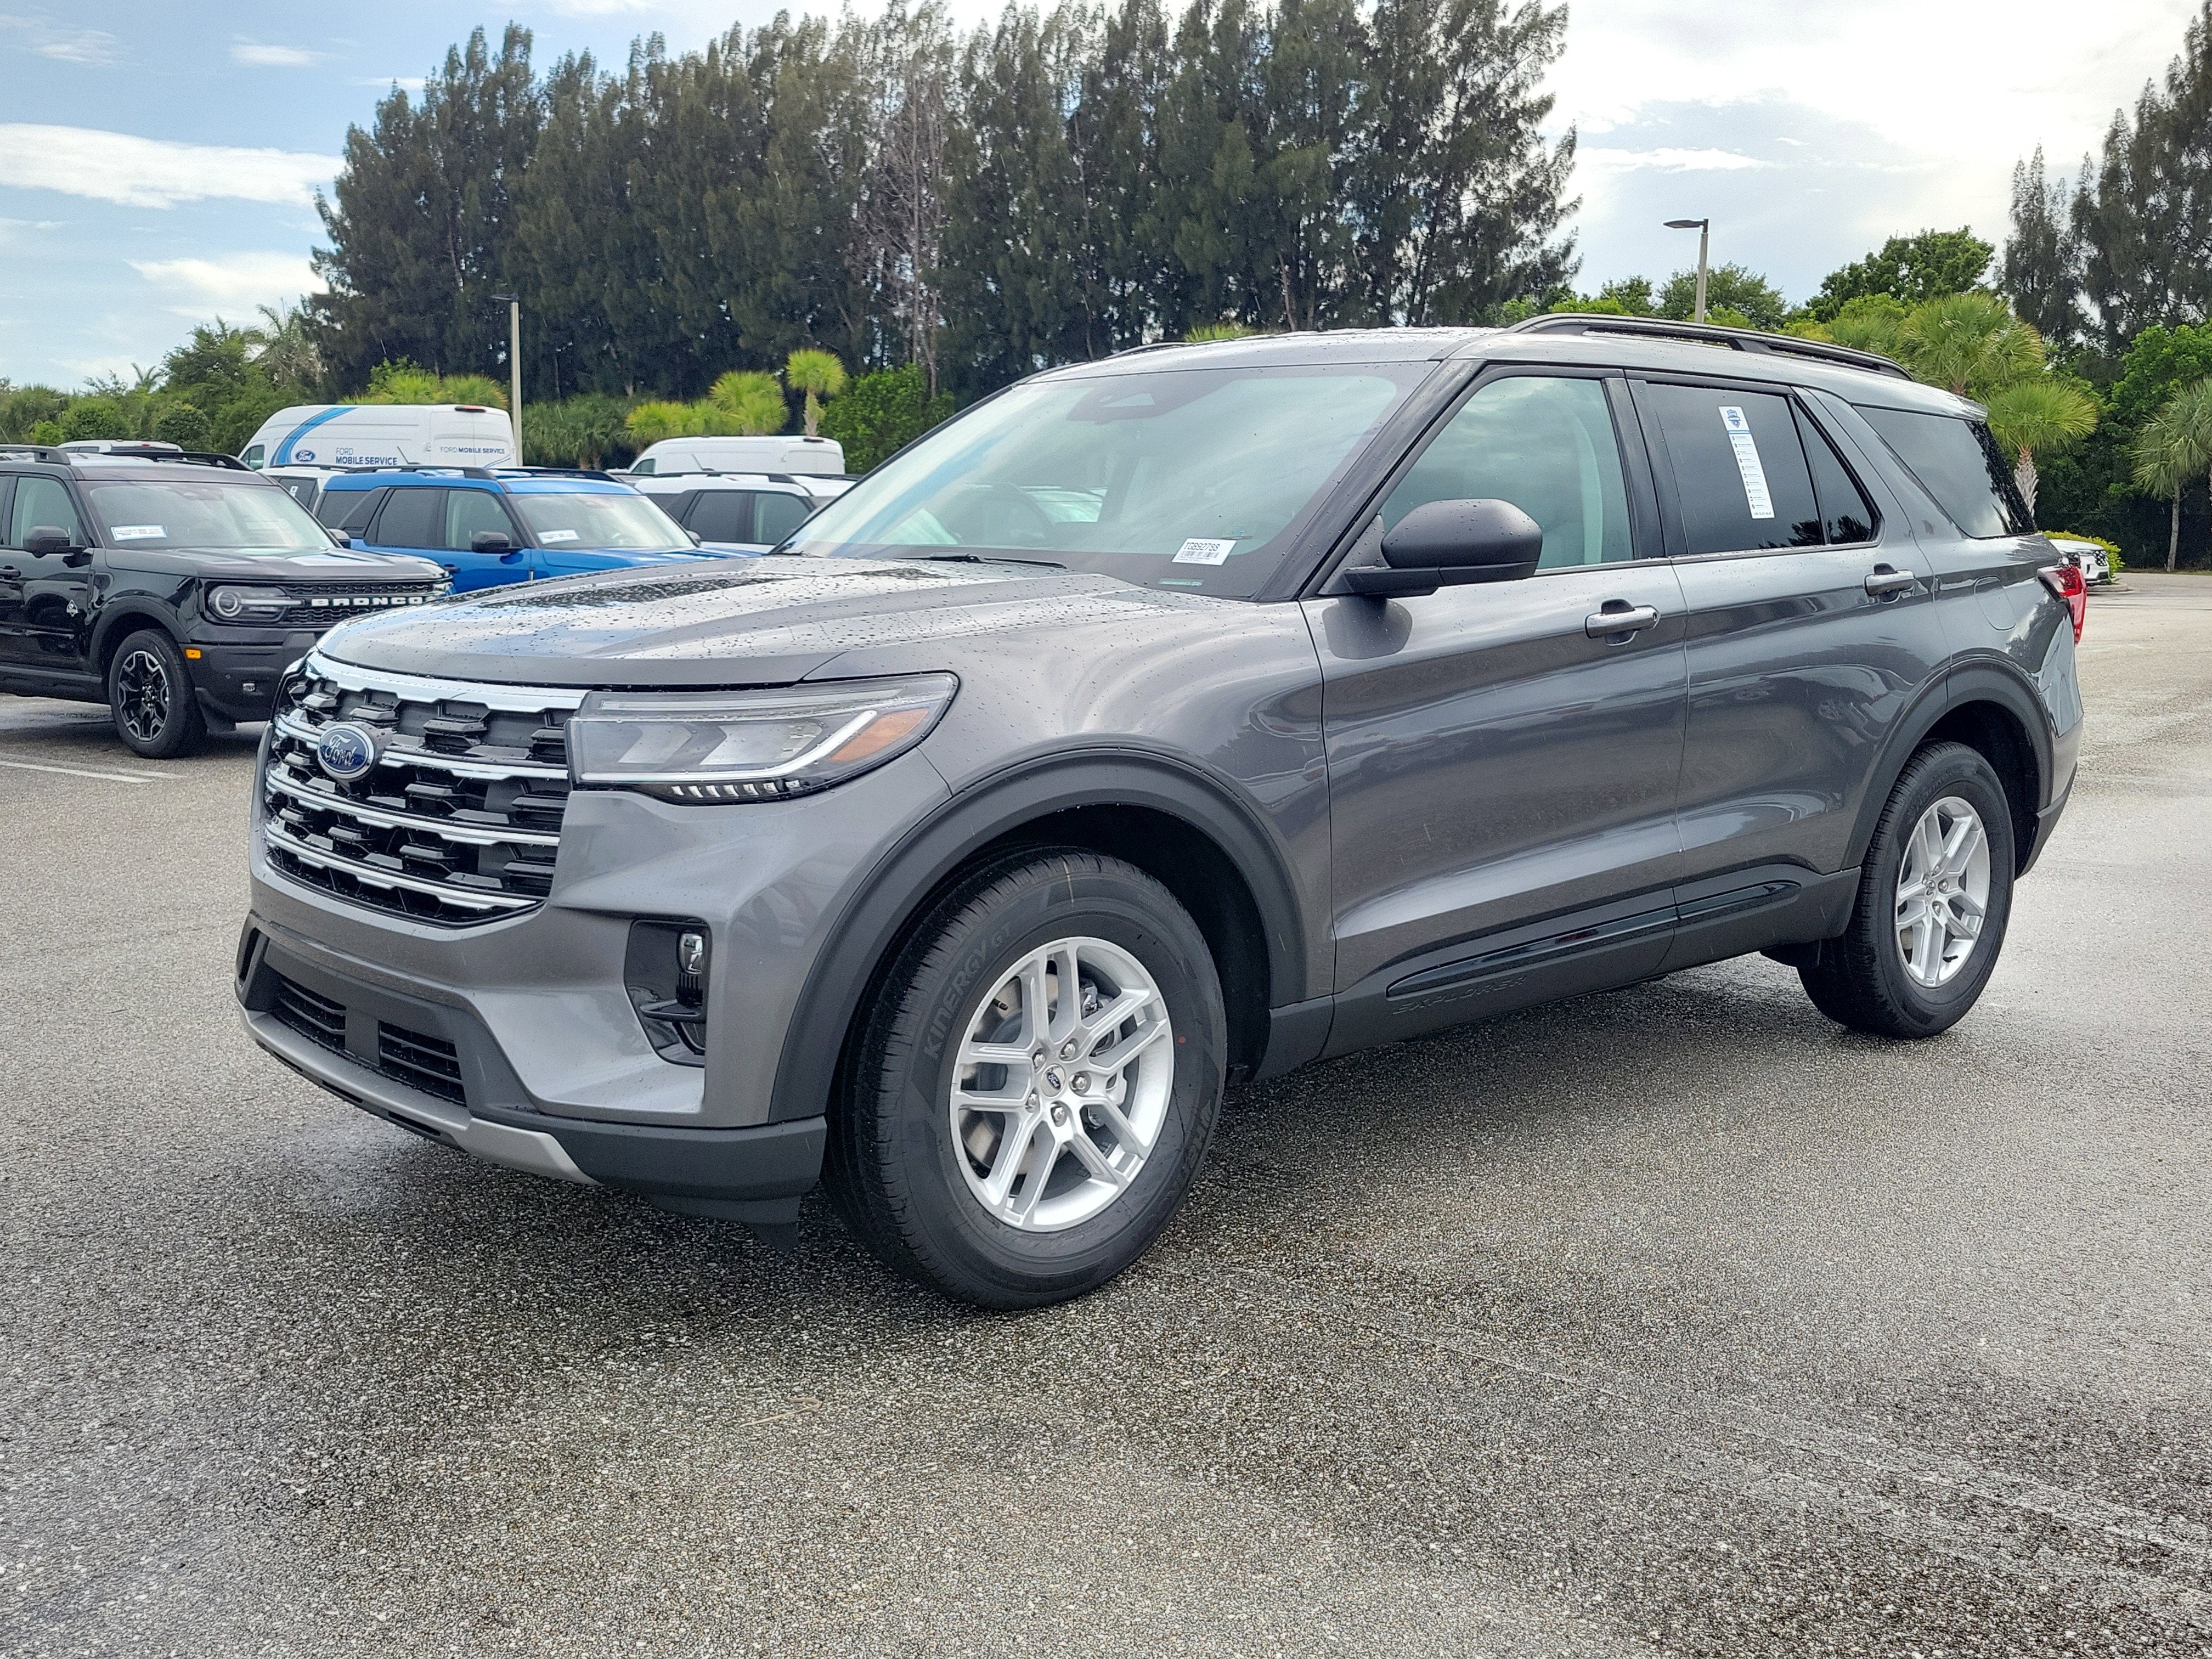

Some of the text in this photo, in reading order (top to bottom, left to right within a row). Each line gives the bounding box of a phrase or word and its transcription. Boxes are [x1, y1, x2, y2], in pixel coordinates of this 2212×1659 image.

[312, 597, 422, 607] BRONCO
[325, 734, 357, 766] Ford
[923, 939, 988, 1060] KINERGY
[1392, 976, 1527, 1015] EXPLORER
